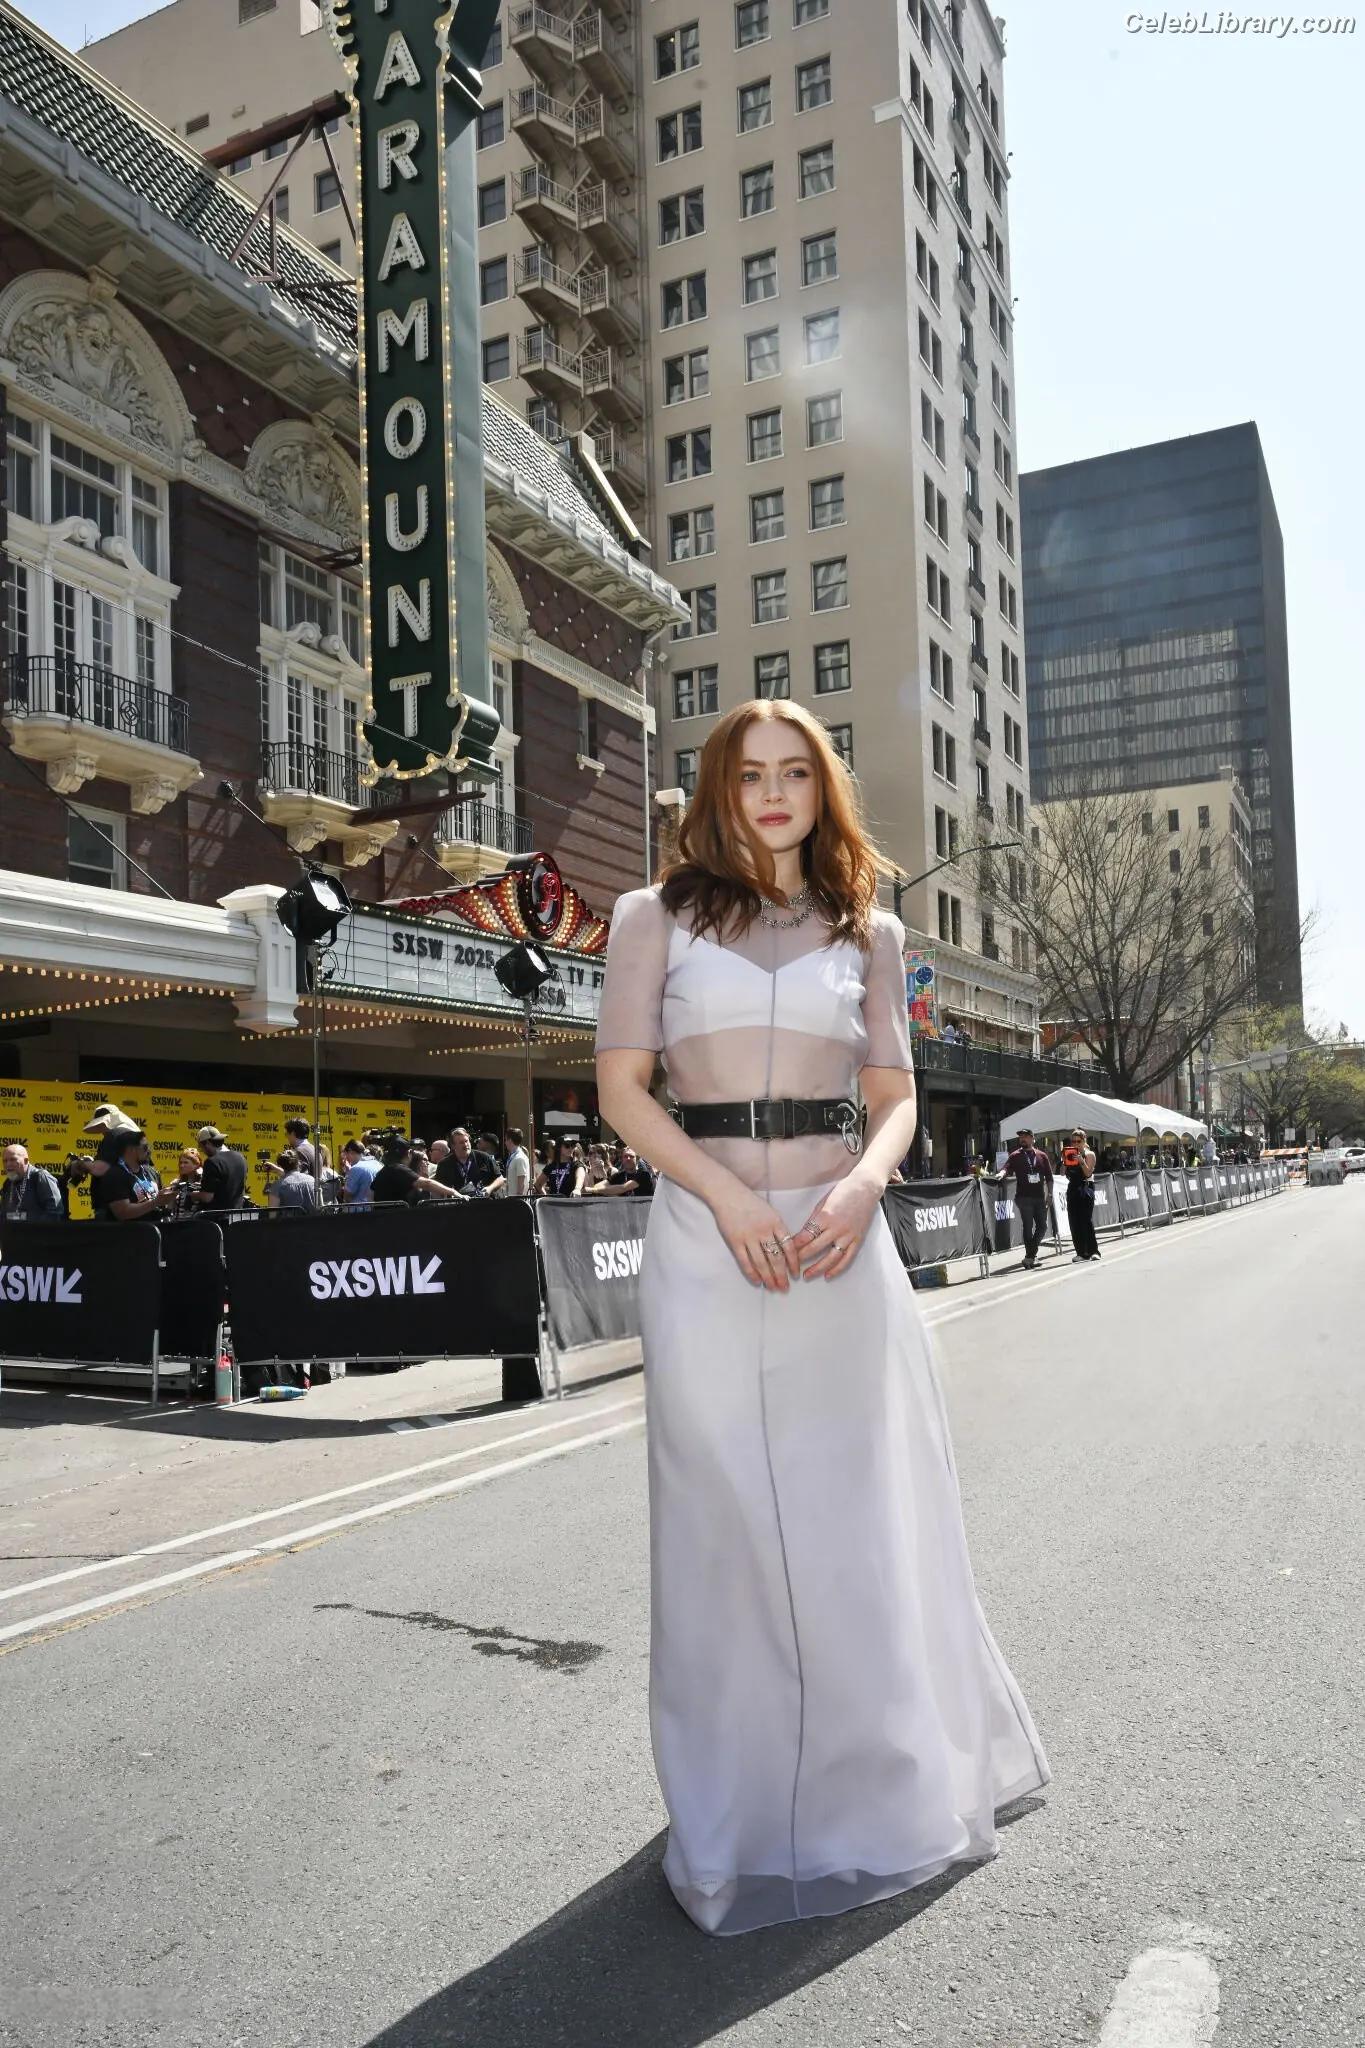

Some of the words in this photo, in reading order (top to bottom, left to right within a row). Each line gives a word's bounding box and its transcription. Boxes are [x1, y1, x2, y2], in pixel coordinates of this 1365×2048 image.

[374, 0, 432, 738] ARAMOUNT
[392, 931, 444, 960] SXSW
[454, 944, 495, 969] 2025
[568, 965, 584, 986] TV
[539, 986, 566, 1007] SSA
[75, 1091, 99, 1102] SXSW
[151, 1096, 174, 1106] SXSW
[220, 1100, 241, 1110] SXSW
[33, 1113, 60, 1124] SXSW
[253, 1122, 273, 1132] SXSW
[153, 1141, 176, 1151] SXSW
[914, 1206, 947, 1232] SXSW
[592, 1238, 644, 1280] SXSW
[308, 1256, 407, 1300] SXSW
